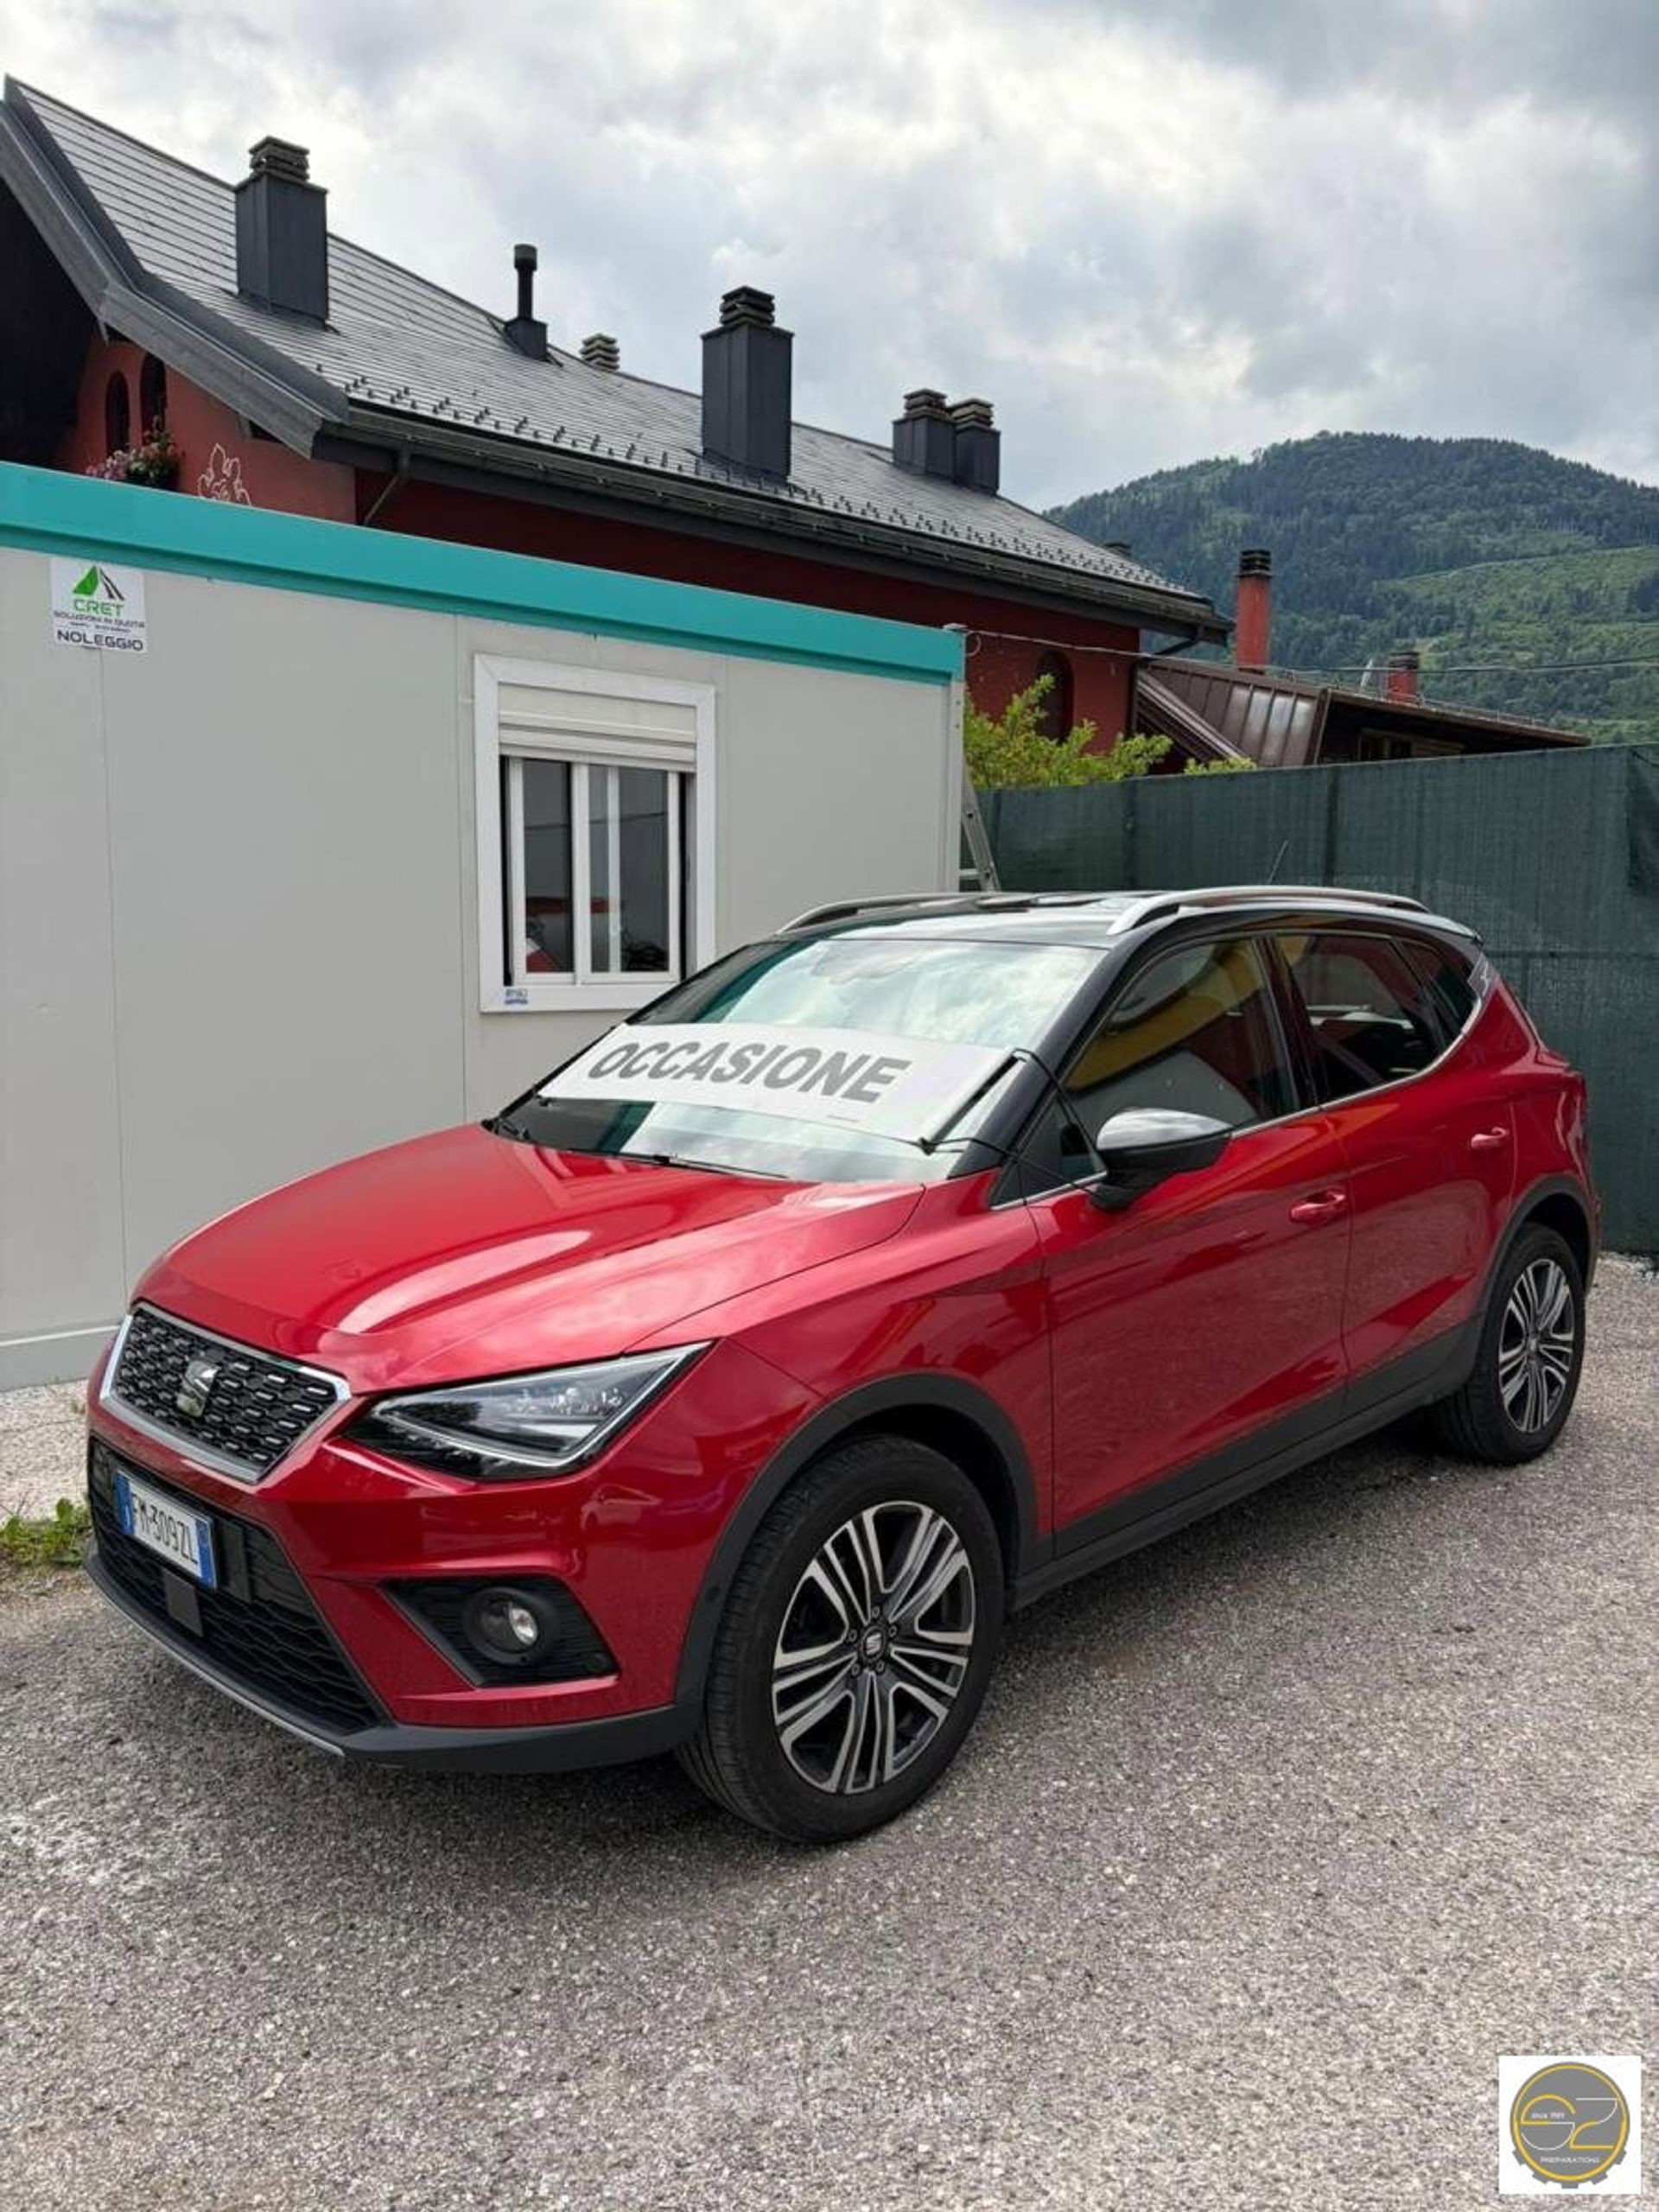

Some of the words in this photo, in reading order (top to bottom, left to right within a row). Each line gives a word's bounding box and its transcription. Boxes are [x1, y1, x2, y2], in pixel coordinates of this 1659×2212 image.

[73, 599, 124, 617] CRET
[57, 629, 143, 652] NOLEGGIO
[587, 1041, 913, 1104] OCCASIONE
